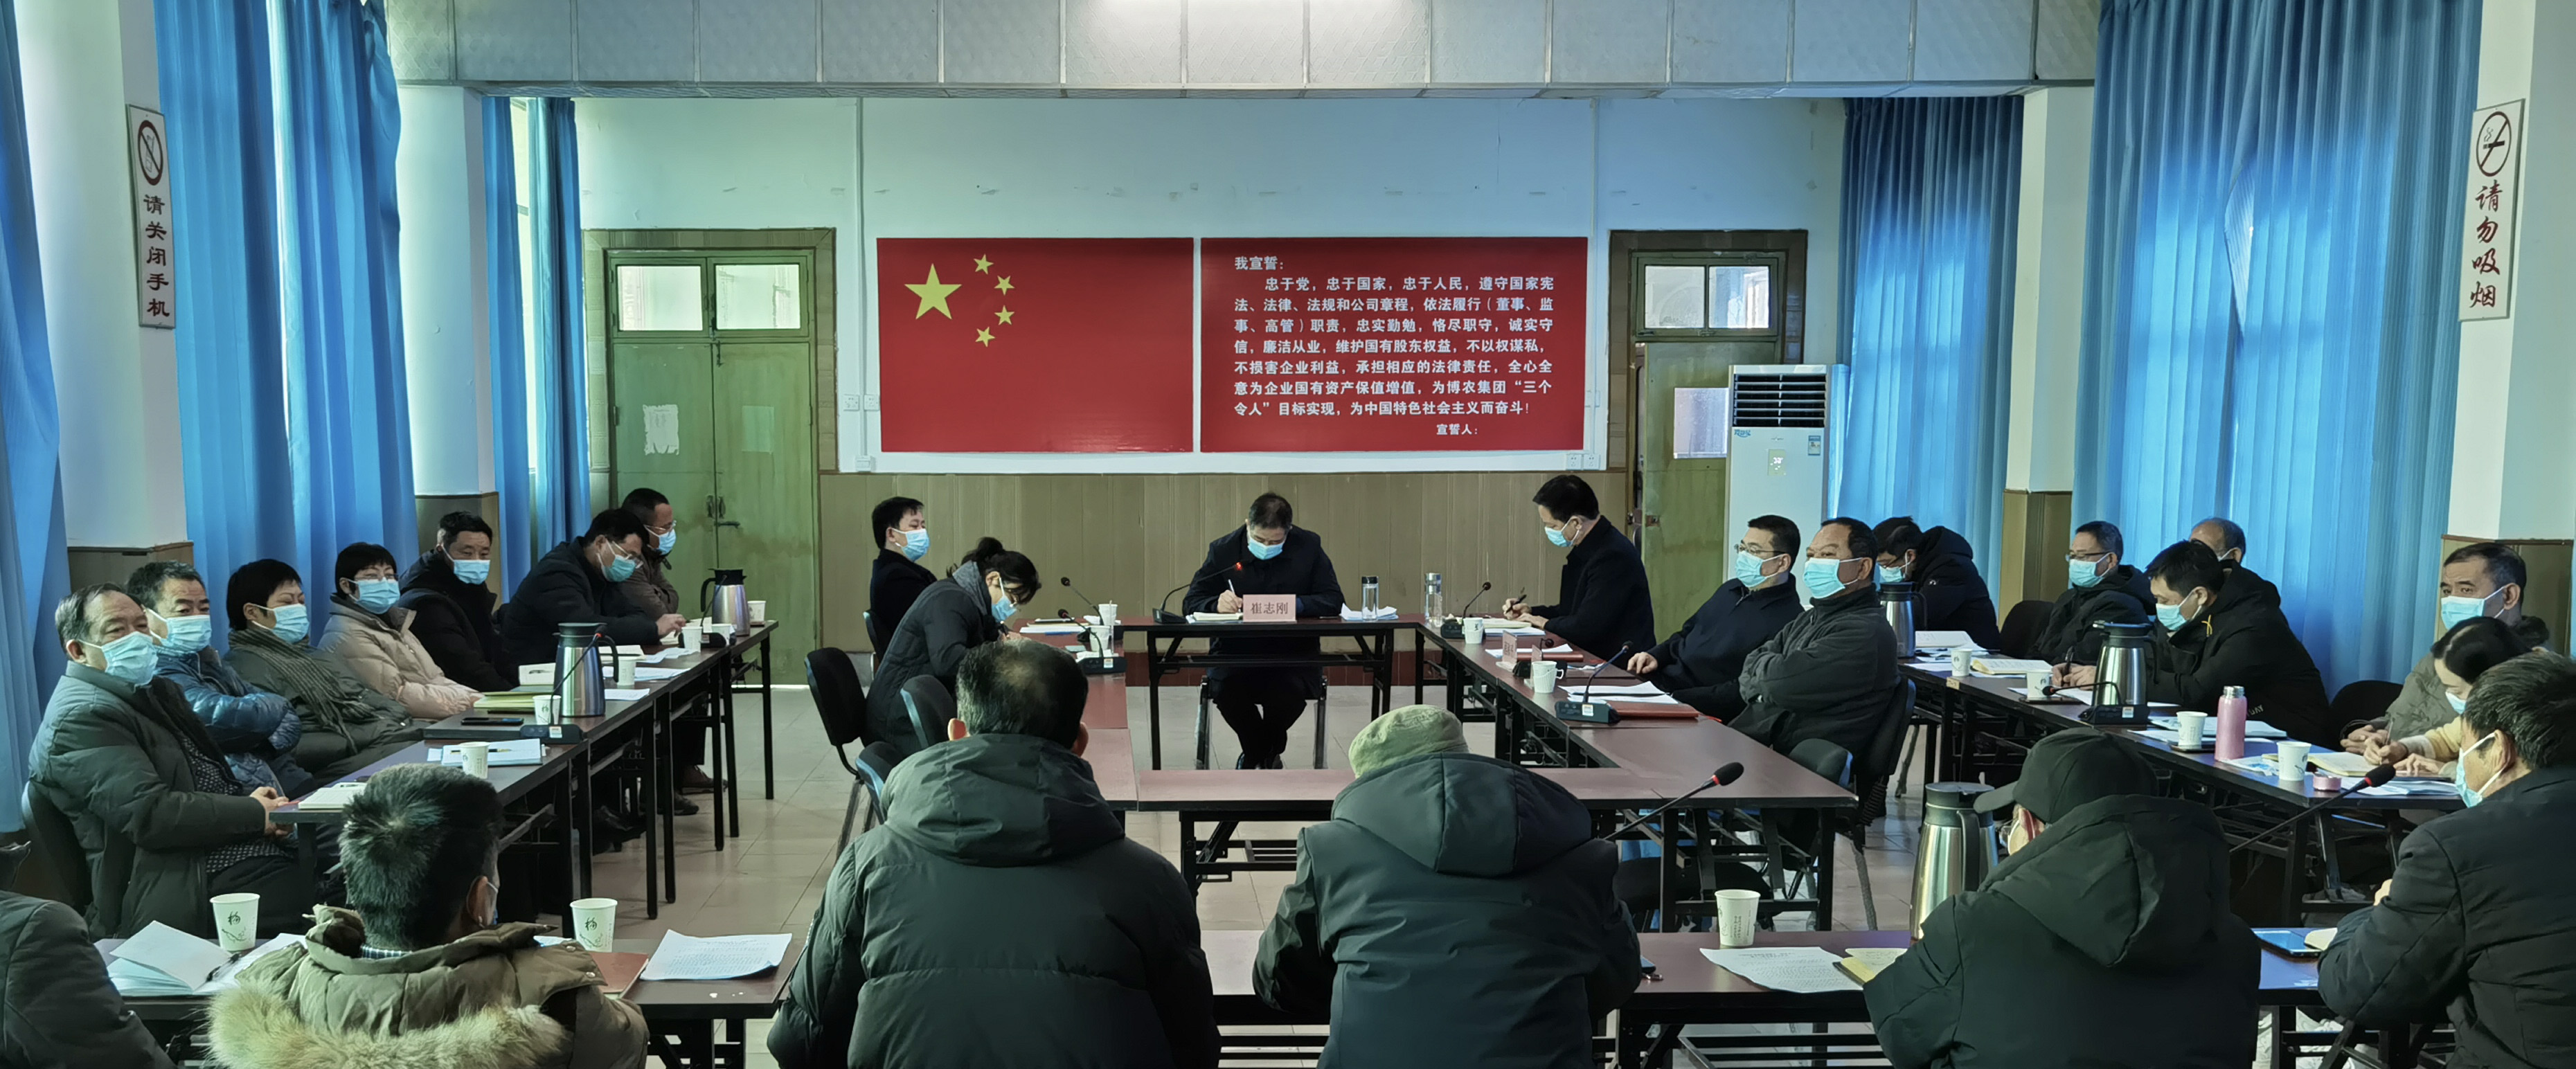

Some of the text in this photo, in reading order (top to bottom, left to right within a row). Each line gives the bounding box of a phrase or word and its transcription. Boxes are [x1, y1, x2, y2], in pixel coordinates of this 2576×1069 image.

[2469, 179, 2503, 307] 请勿吸烟
[143, 194, 170, 317] 请关闭手机
[1235, 255, 1283, 271] 我宣誓：
[1264, 276, 1554, 291] 忠于党，忠于国家，忠于人民，遵守国家宪
[1234, 359, 1553, 375] 不损害企业利益，承担相应的法律责任，全心全
[1436, 423, 1478, 435] 宣誓人：
[1250, 602, 1289, 615] 崔志刚
